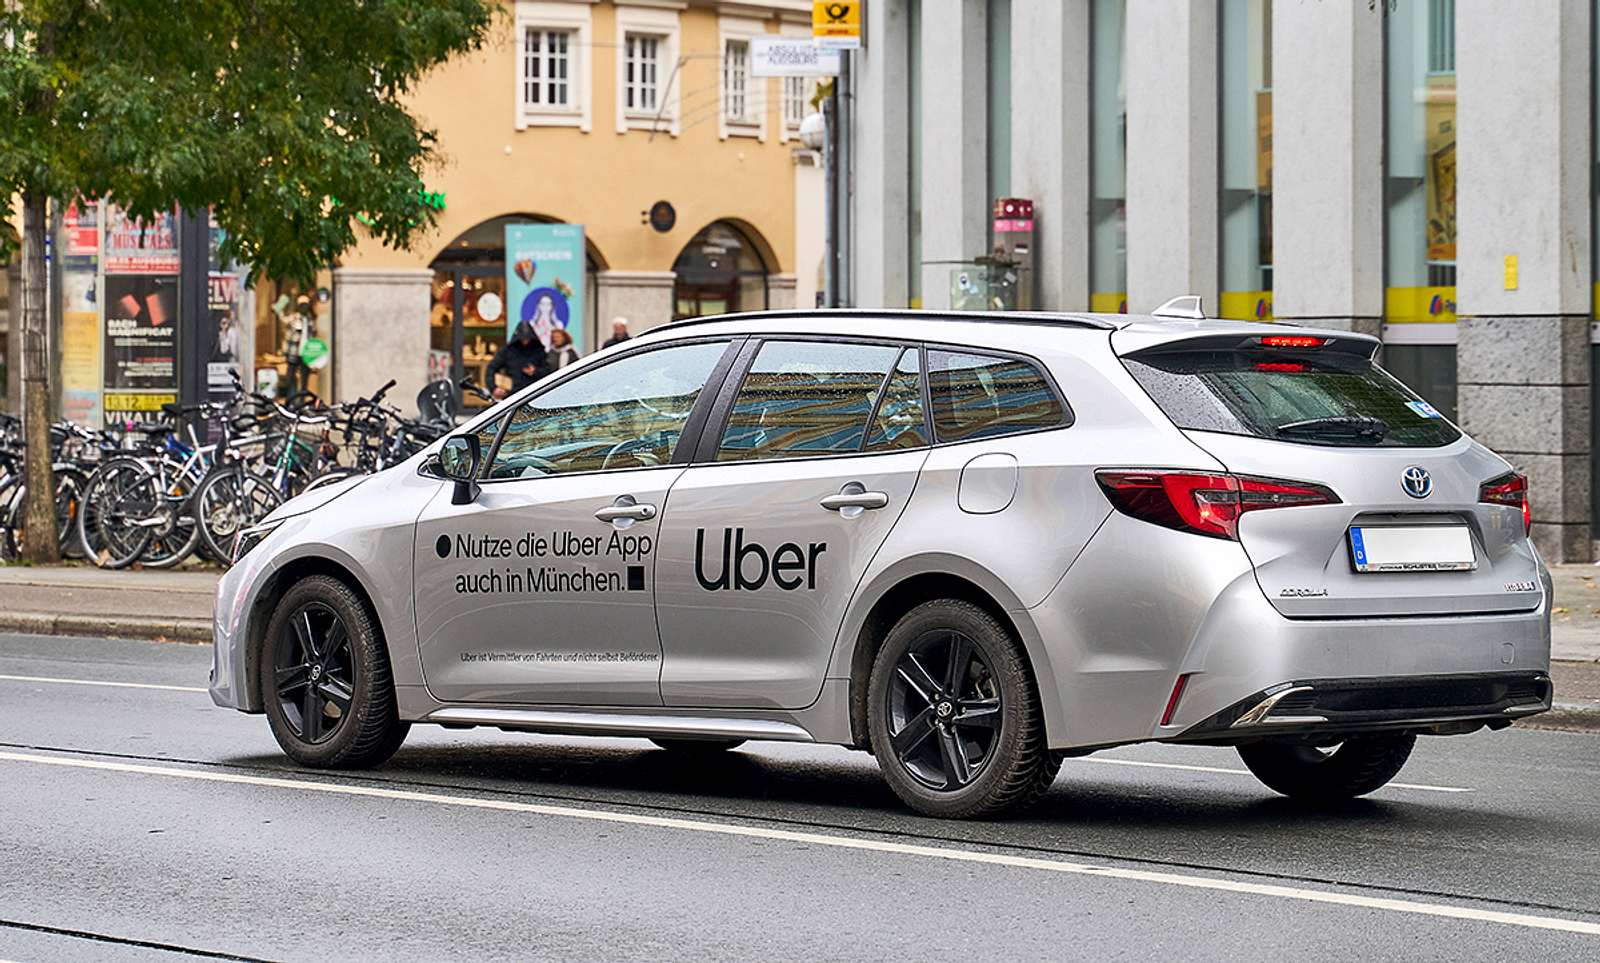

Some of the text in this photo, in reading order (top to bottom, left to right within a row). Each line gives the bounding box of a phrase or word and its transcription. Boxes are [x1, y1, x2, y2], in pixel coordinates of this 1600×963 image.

[112, 233, 172, 249] MUSCALS
[107, 327, 173, 336] MAGNIFICAT
[455, 530, 651, 562] Nutze die Uber App
[695, 527, 827, 591] Uber
[455, 566, 625, 593] auch in München.
[460, 653, 478, 662] Uber
[478, 653, 487, 662] ist
[488, 653, 521, 662] Vermittler
[521, 654, 535, 662] von
[536, 652, 563, 662] Fahrten
[563, 653, 578, 662] und
[578, 652, 597, 662] nicht
[598, 652, 619, 662] selbst
